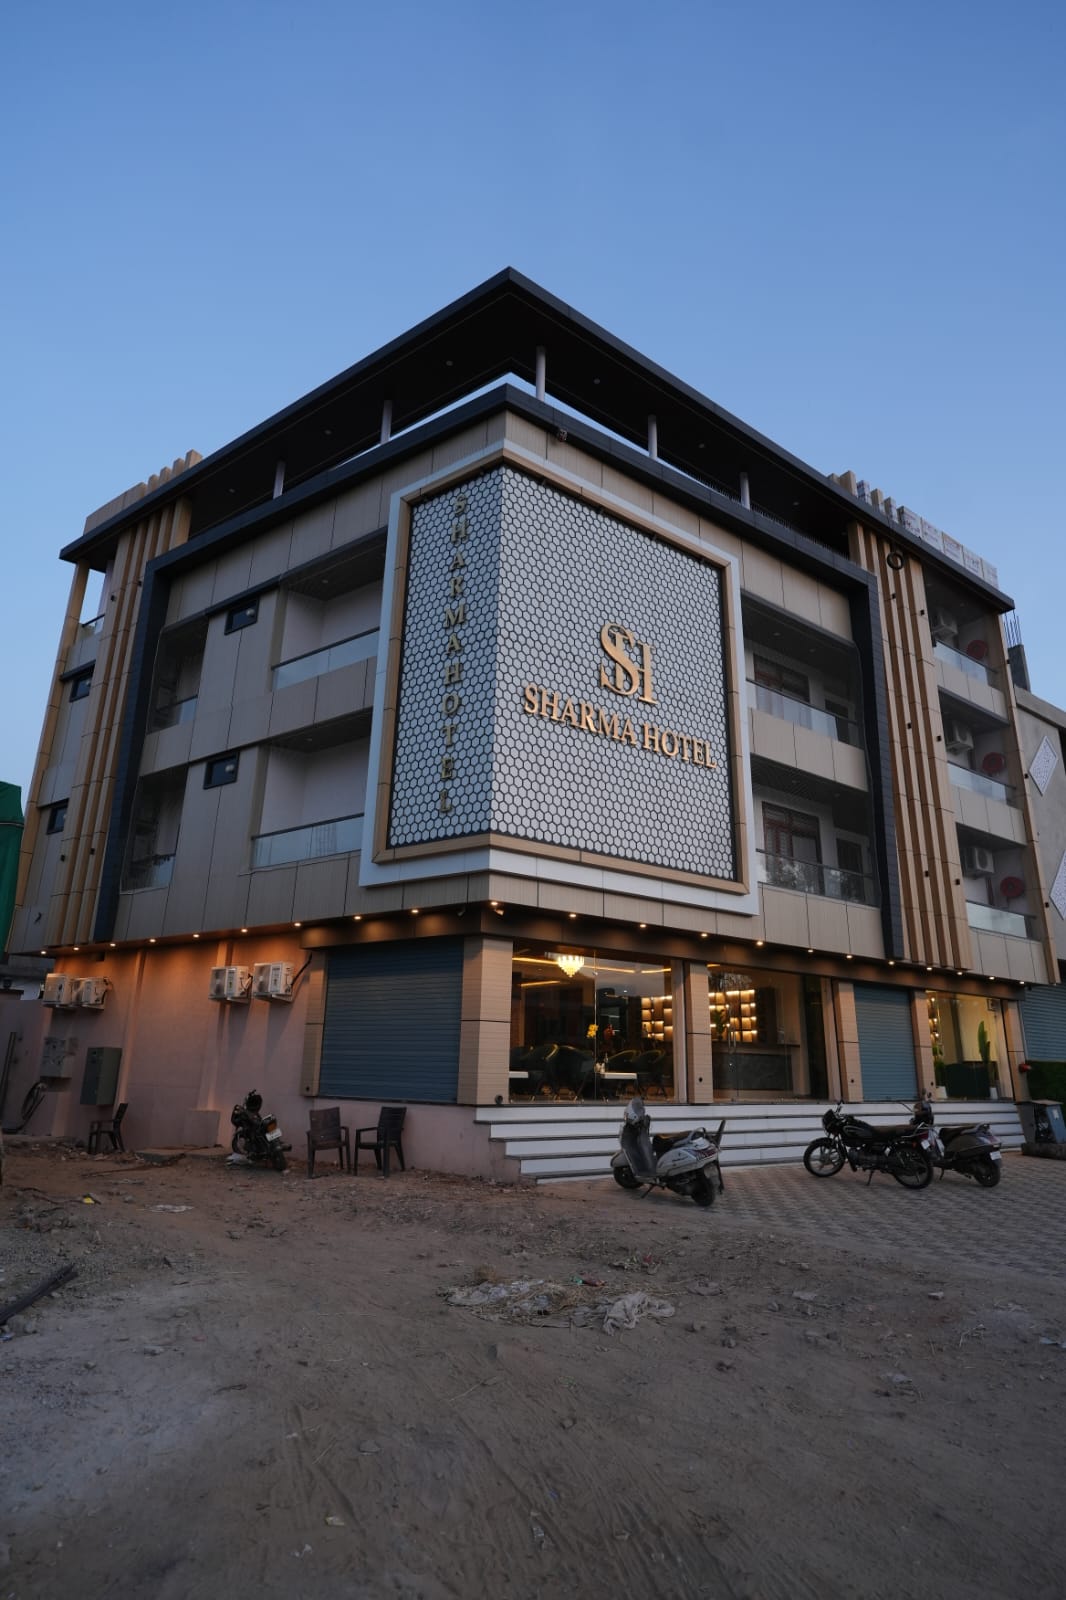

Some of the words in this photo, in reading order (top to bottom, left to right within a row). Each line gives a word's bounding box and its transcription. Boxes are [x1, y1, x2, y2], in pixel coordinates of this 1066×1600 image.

[445, 493, 469, 657] SHARMA
[440, 662, 462, 813] HOTEL
[524, 683, 636, 745] SHARMA
[643, 723, 717, 769] HOTEL
